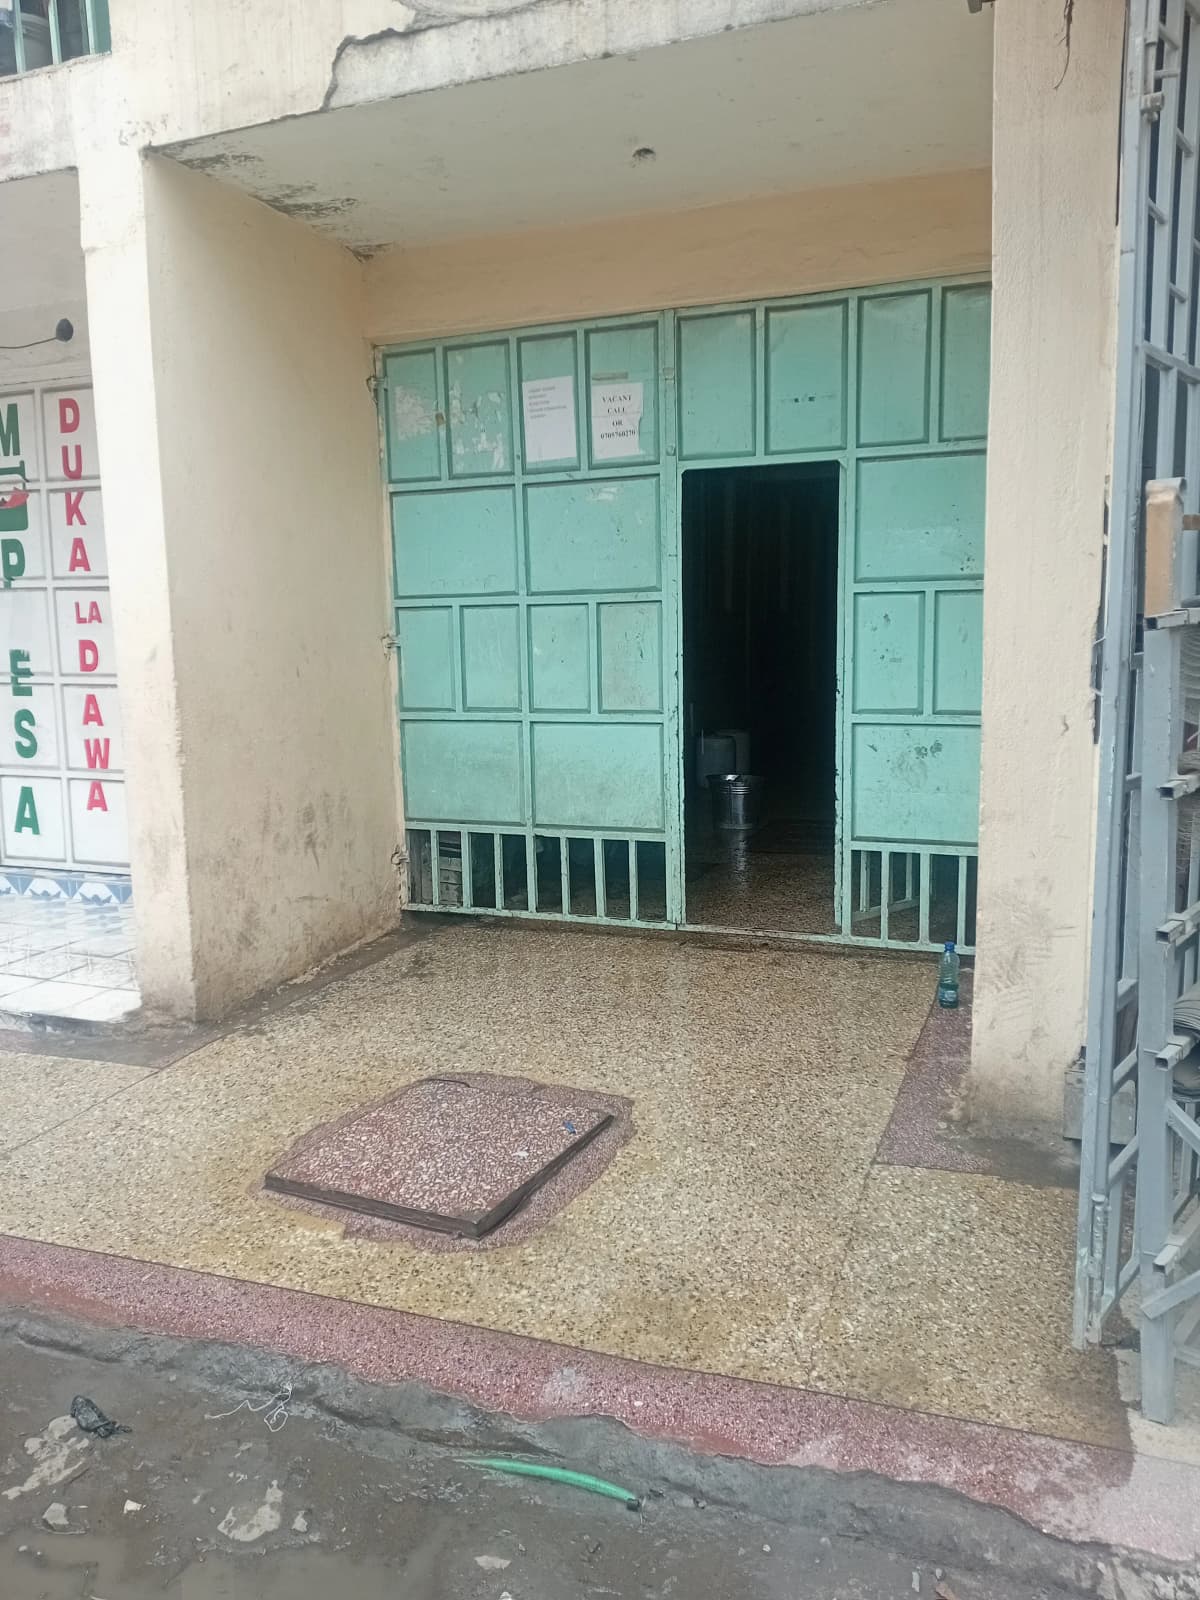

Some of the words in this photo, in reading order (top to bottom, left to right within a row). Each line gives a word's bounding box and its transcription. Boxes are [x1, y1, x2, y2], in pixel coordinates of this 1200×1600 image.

[602, 394, 632, 403] VACANT
[607, 406, 626, 414] CALL
[58, 398, 91, 572] DUKA
[75, 601, 102, 624] LA
[78, 640, 110, 811] DAWA
